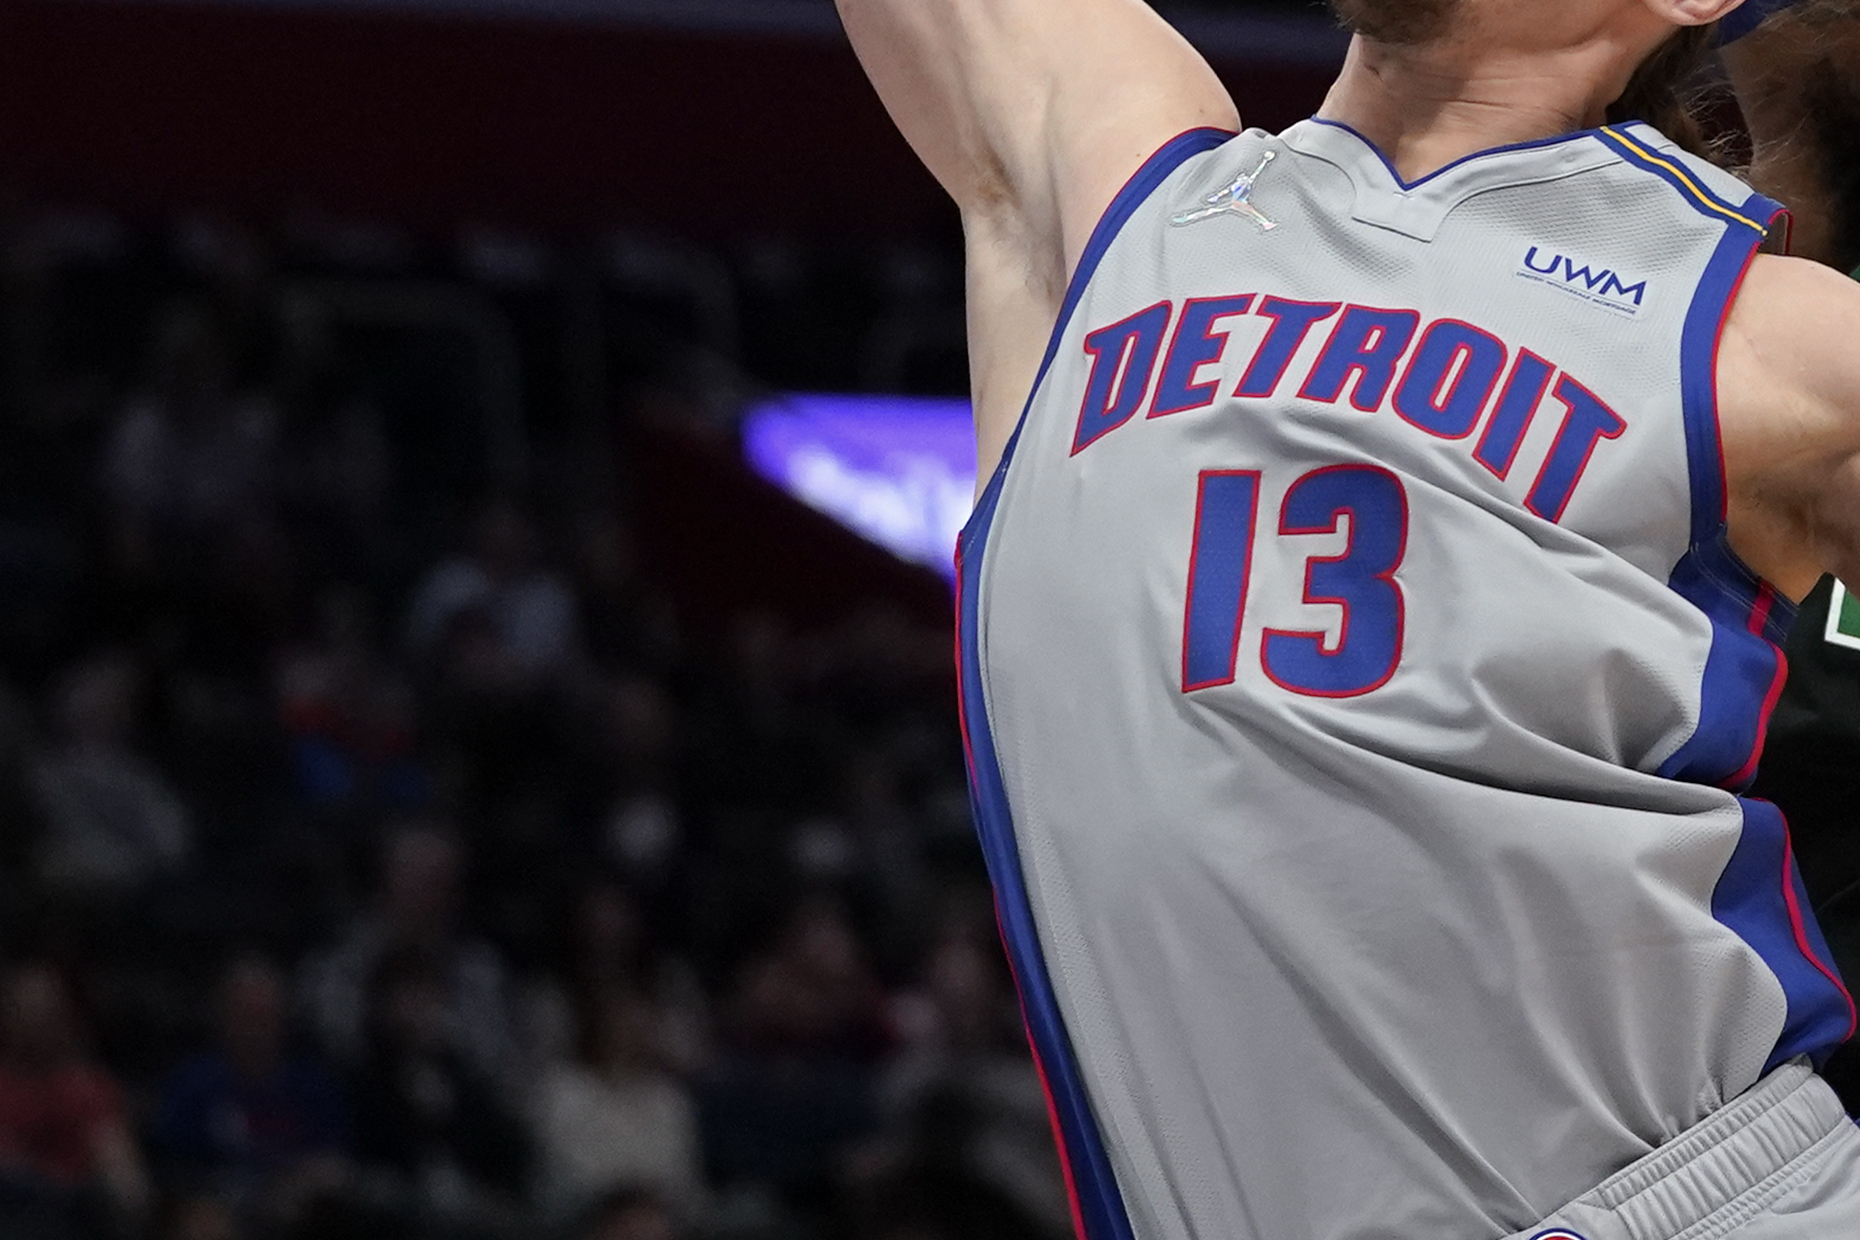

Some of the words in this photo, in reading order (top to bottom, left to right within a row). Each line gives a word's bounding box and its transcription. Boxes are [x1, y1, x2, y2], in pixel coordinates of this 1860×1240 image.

[1524, 246, 1647, 306] UWM
[1070, 293, 1627, 525] DETROIT
[1181, 464, 1409, 699] 13
